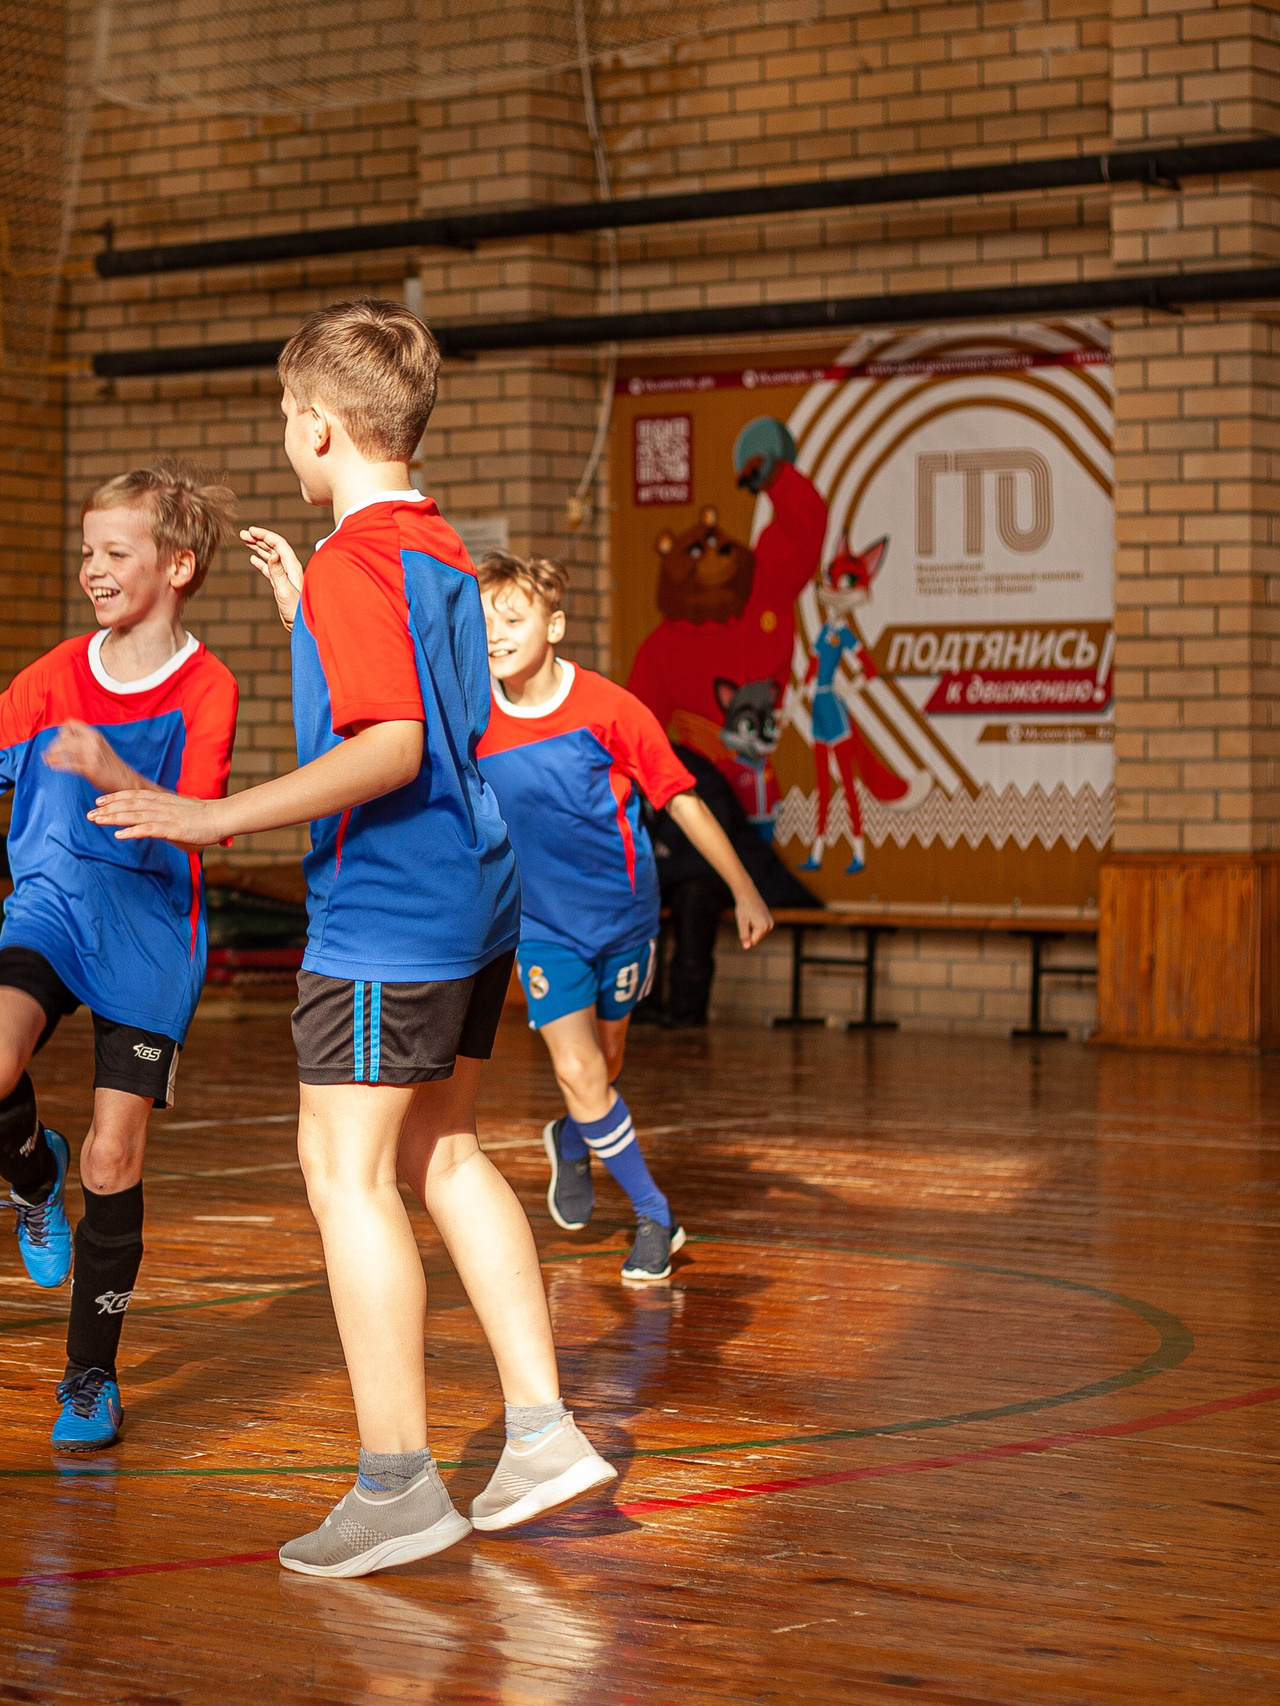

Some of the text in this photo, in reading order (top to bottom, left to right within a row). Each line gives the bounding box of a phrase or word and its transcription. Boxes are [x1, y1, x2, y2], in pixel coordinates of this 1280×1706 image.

[916, 447, 1053, 556] ГТО
[945, 680, 964, 704] к
[614, 962, 639, 1003] 9
